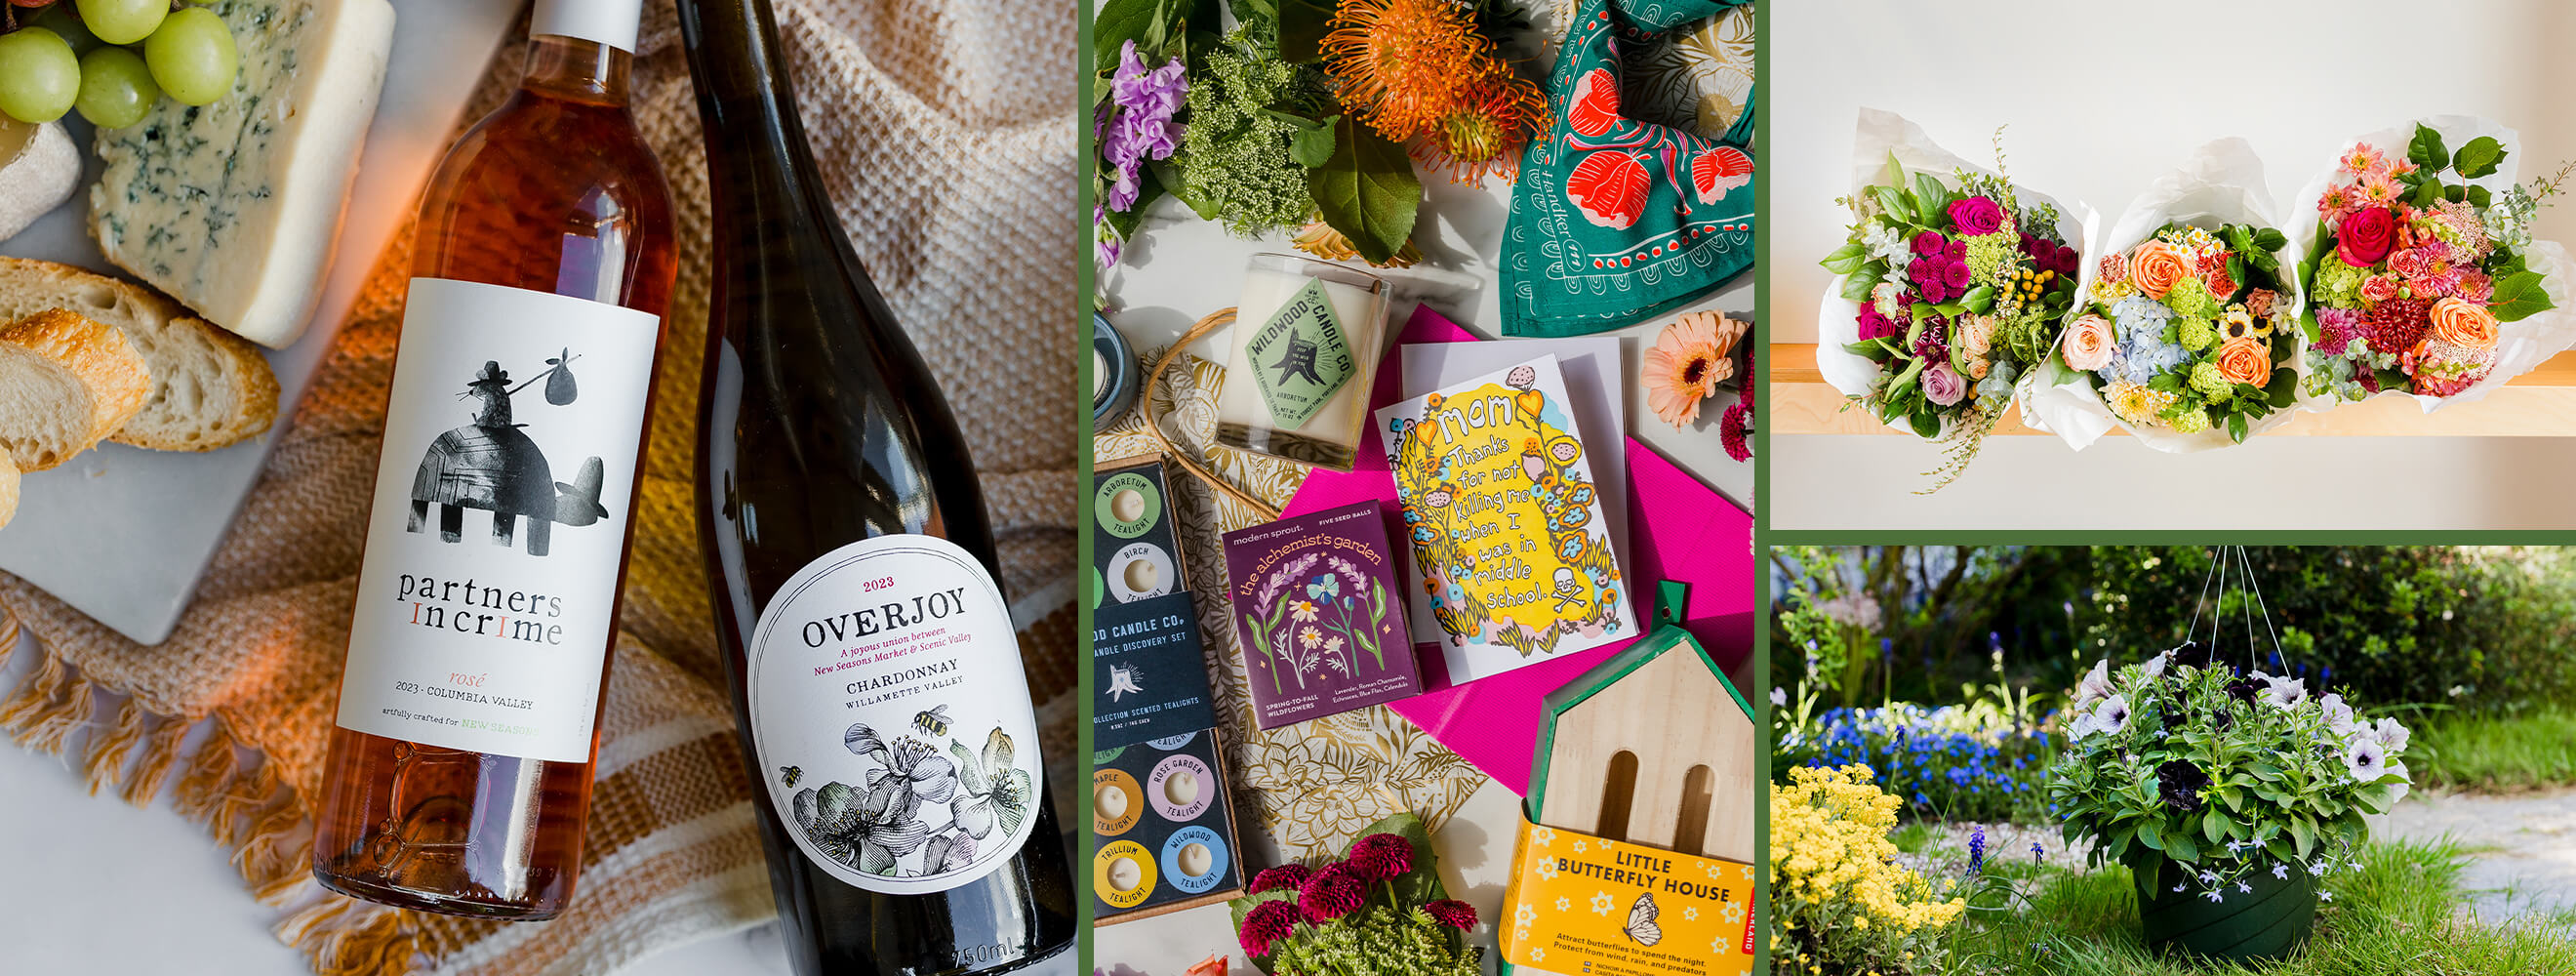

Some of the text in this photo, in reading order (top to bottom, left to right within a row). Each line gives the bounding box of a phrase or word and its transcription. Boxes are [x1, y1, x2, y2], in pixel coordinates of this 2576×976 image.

[1542, 170, 1572, 238] Handker
[1251, 301, 1308, 355] WILDWOOD
[1313, 305, 1343, 351] CANDLE
[1447, 434, 1509, 468] Thanks
[1457, 460, 1520, 490] for not
[1103, 477, 1147, 498] ARBORETUM
[1507, 489, 1530, 504] me
[1114, 517, 1149, 533] TEALIGHT
[1319, 509, 1372, 526] FIVE SEED BALLS
[1460, 513, 1520, 543] when I
[1233, 525, 1304, 546] modern sprout.
[1124, 548, 1149, 558] BIRCH
[1478, 534, 1537, 562] was in
[1241, 573, 1259, 597] the
[1333, 537, 1382, 566] garden
[1474, 556, 1532, 586] middle
[397, 573, 563, 618] partners
[863, 576, 895, 592] 2023
[1487, 582, 1548, 609] school.
[802, 588, 966, 648] OVERJOY
[1112, 619, 1157, 637] CANDLE
[841, 627, 946, 658] A joyous union between
[1095, 632, 1187, 658] ANDLE DISCOVERY SET
[814, 632, 972, 677] New Seasons Market & Scenic Valley
[449, 671, 487, 688] rosé
[847, 659, 958, 695] CHARDONNAY
[395, 681, 534, 710] 2023 COLUMBIA VALLEY
[845, 675, 964, 710] WILLAMETTE VALLEY
[1266, 695, 1319, 711] SPRING-TO-FALL
[1132, 705, 1161, 716] SCENTED
[1164, 697, 1199, 711] TEALIGHTS
[1267, 703, 1315, 717] WILDFLOWERS
[382, 708, 412, 719] artfully
[414, 712, 443, 724] crafted
[445, 717, 460, 726] for
[462, 718, 488, 730] NEW
[1094, 774, 1118, 785] MAPLE
[1153, 759, 1204, 783] ROSE GARDEN
[1167, 800, 1204, 818] TEALIGHT
[1097, 816, 1132, 832] TEALIGHT
[1171, 831, 1211, 849] WILDWOOD
[1101, 843, 1138, 861] TRILLIUM
[1616, 851, 1670, 874] LITTLE
[1181, 873, 1218, 889] TEALIGHT
[1557, 858, 1729, 902] BUTTERFLY HOUSE
[1109, 886, 1147, 904] TEALIGHT
[1557, 933, 1585, 944] Attract
[1588, 939, 1630, 953] butterflies
[1641, 951, 1667, 959] spend
[1553, 941, 1583, 953] Protect
[1668, 963, 1706, 976] predators
